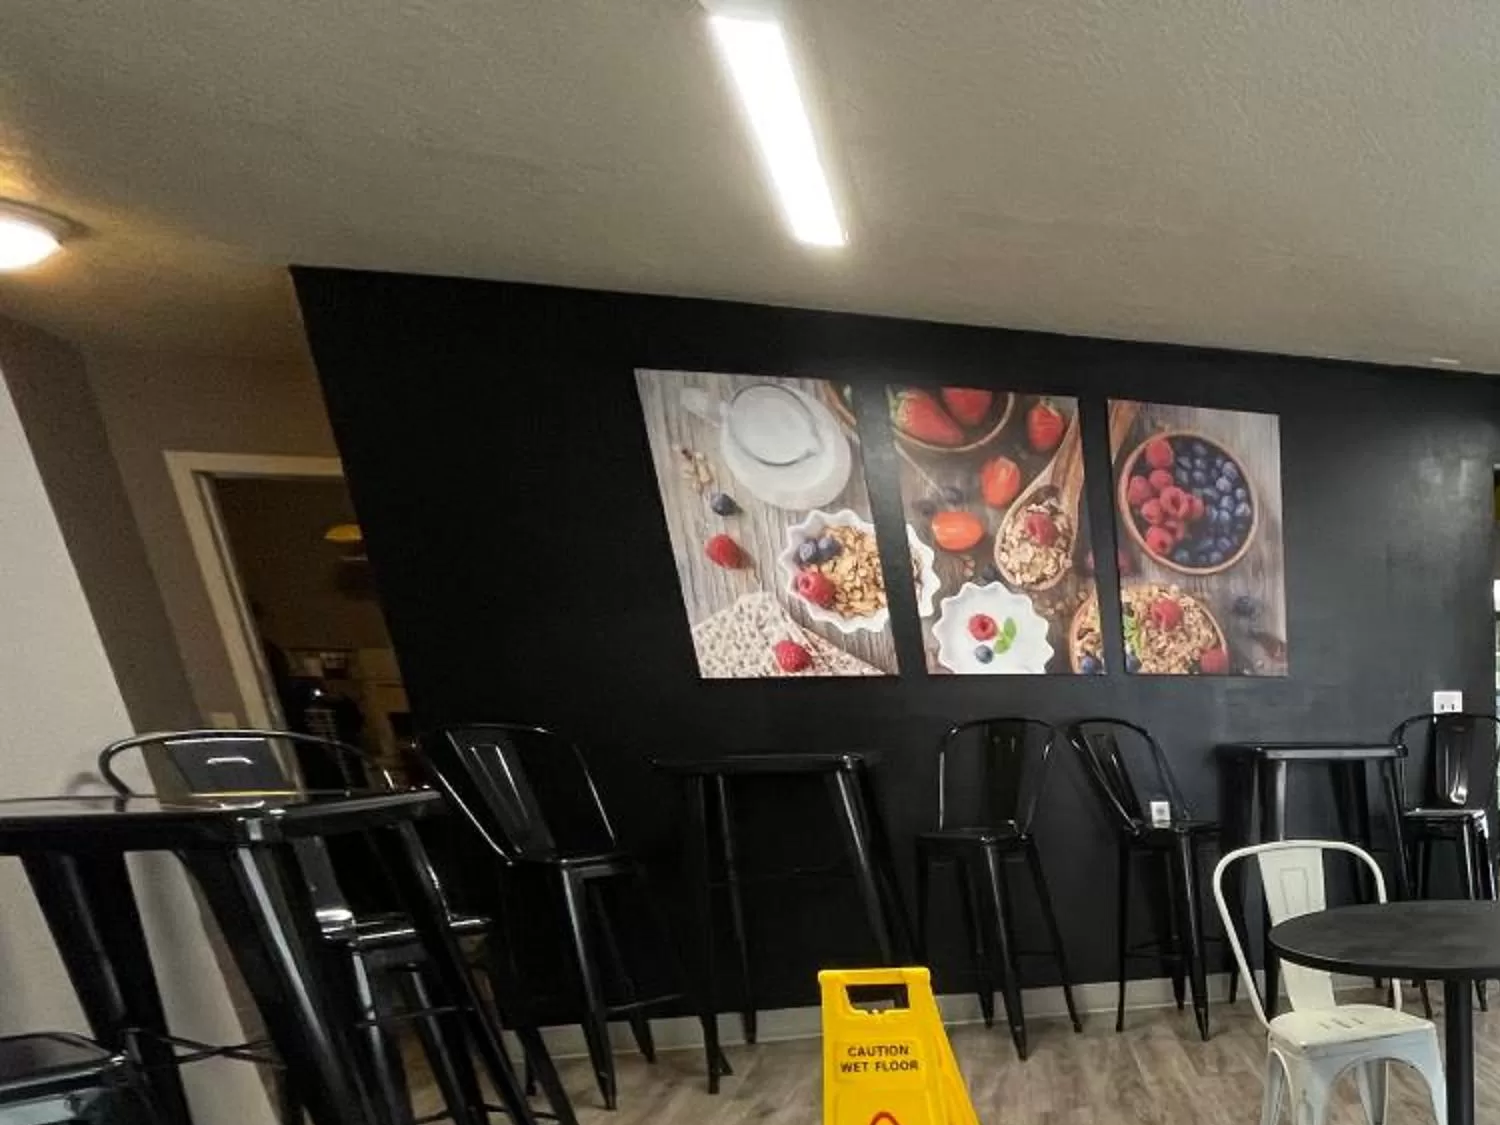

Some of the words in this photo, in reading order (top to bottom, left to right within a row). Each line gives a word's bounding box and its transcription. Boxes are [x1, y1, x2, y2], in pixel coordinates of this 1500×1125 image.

[847, 1044, 909, 1057] CAUTION
[840, 1061, 869, 1072] WET
[875, 1059, 918, 1072] FLOOR
